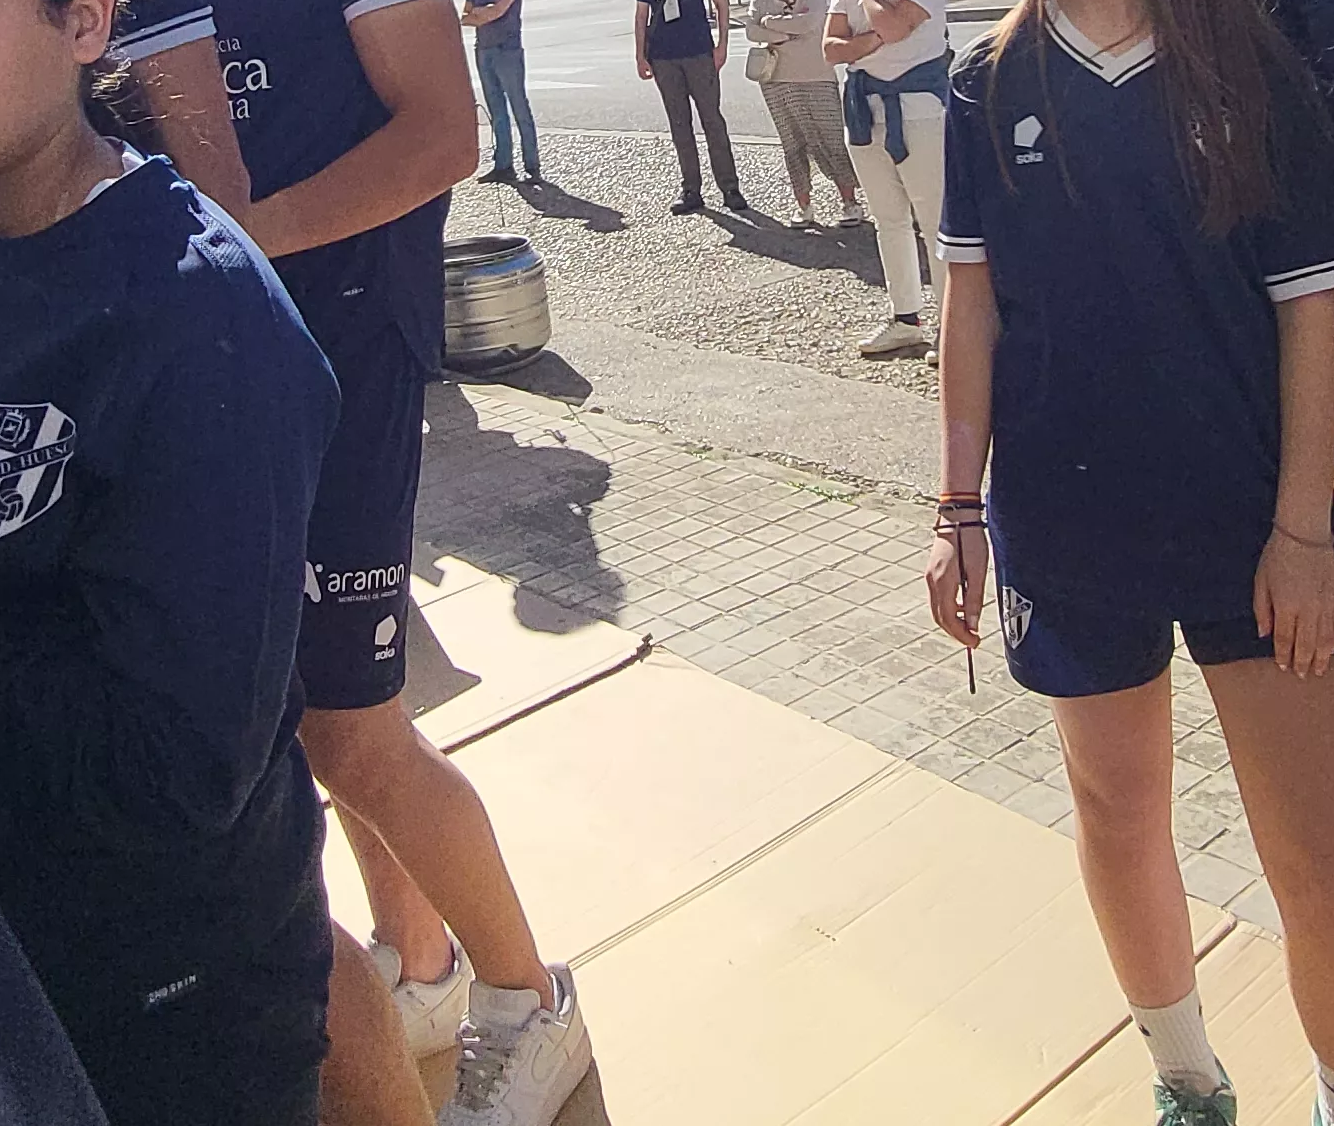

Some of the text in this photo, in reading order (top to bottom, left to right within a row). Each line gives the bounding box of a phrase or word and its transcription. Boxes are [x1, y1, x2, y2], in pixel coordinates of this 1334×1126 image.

[222, 58, 273, 94] ca
[1015, 151, 1044, 165] soka
[327, 563, 405, 593] aramon
